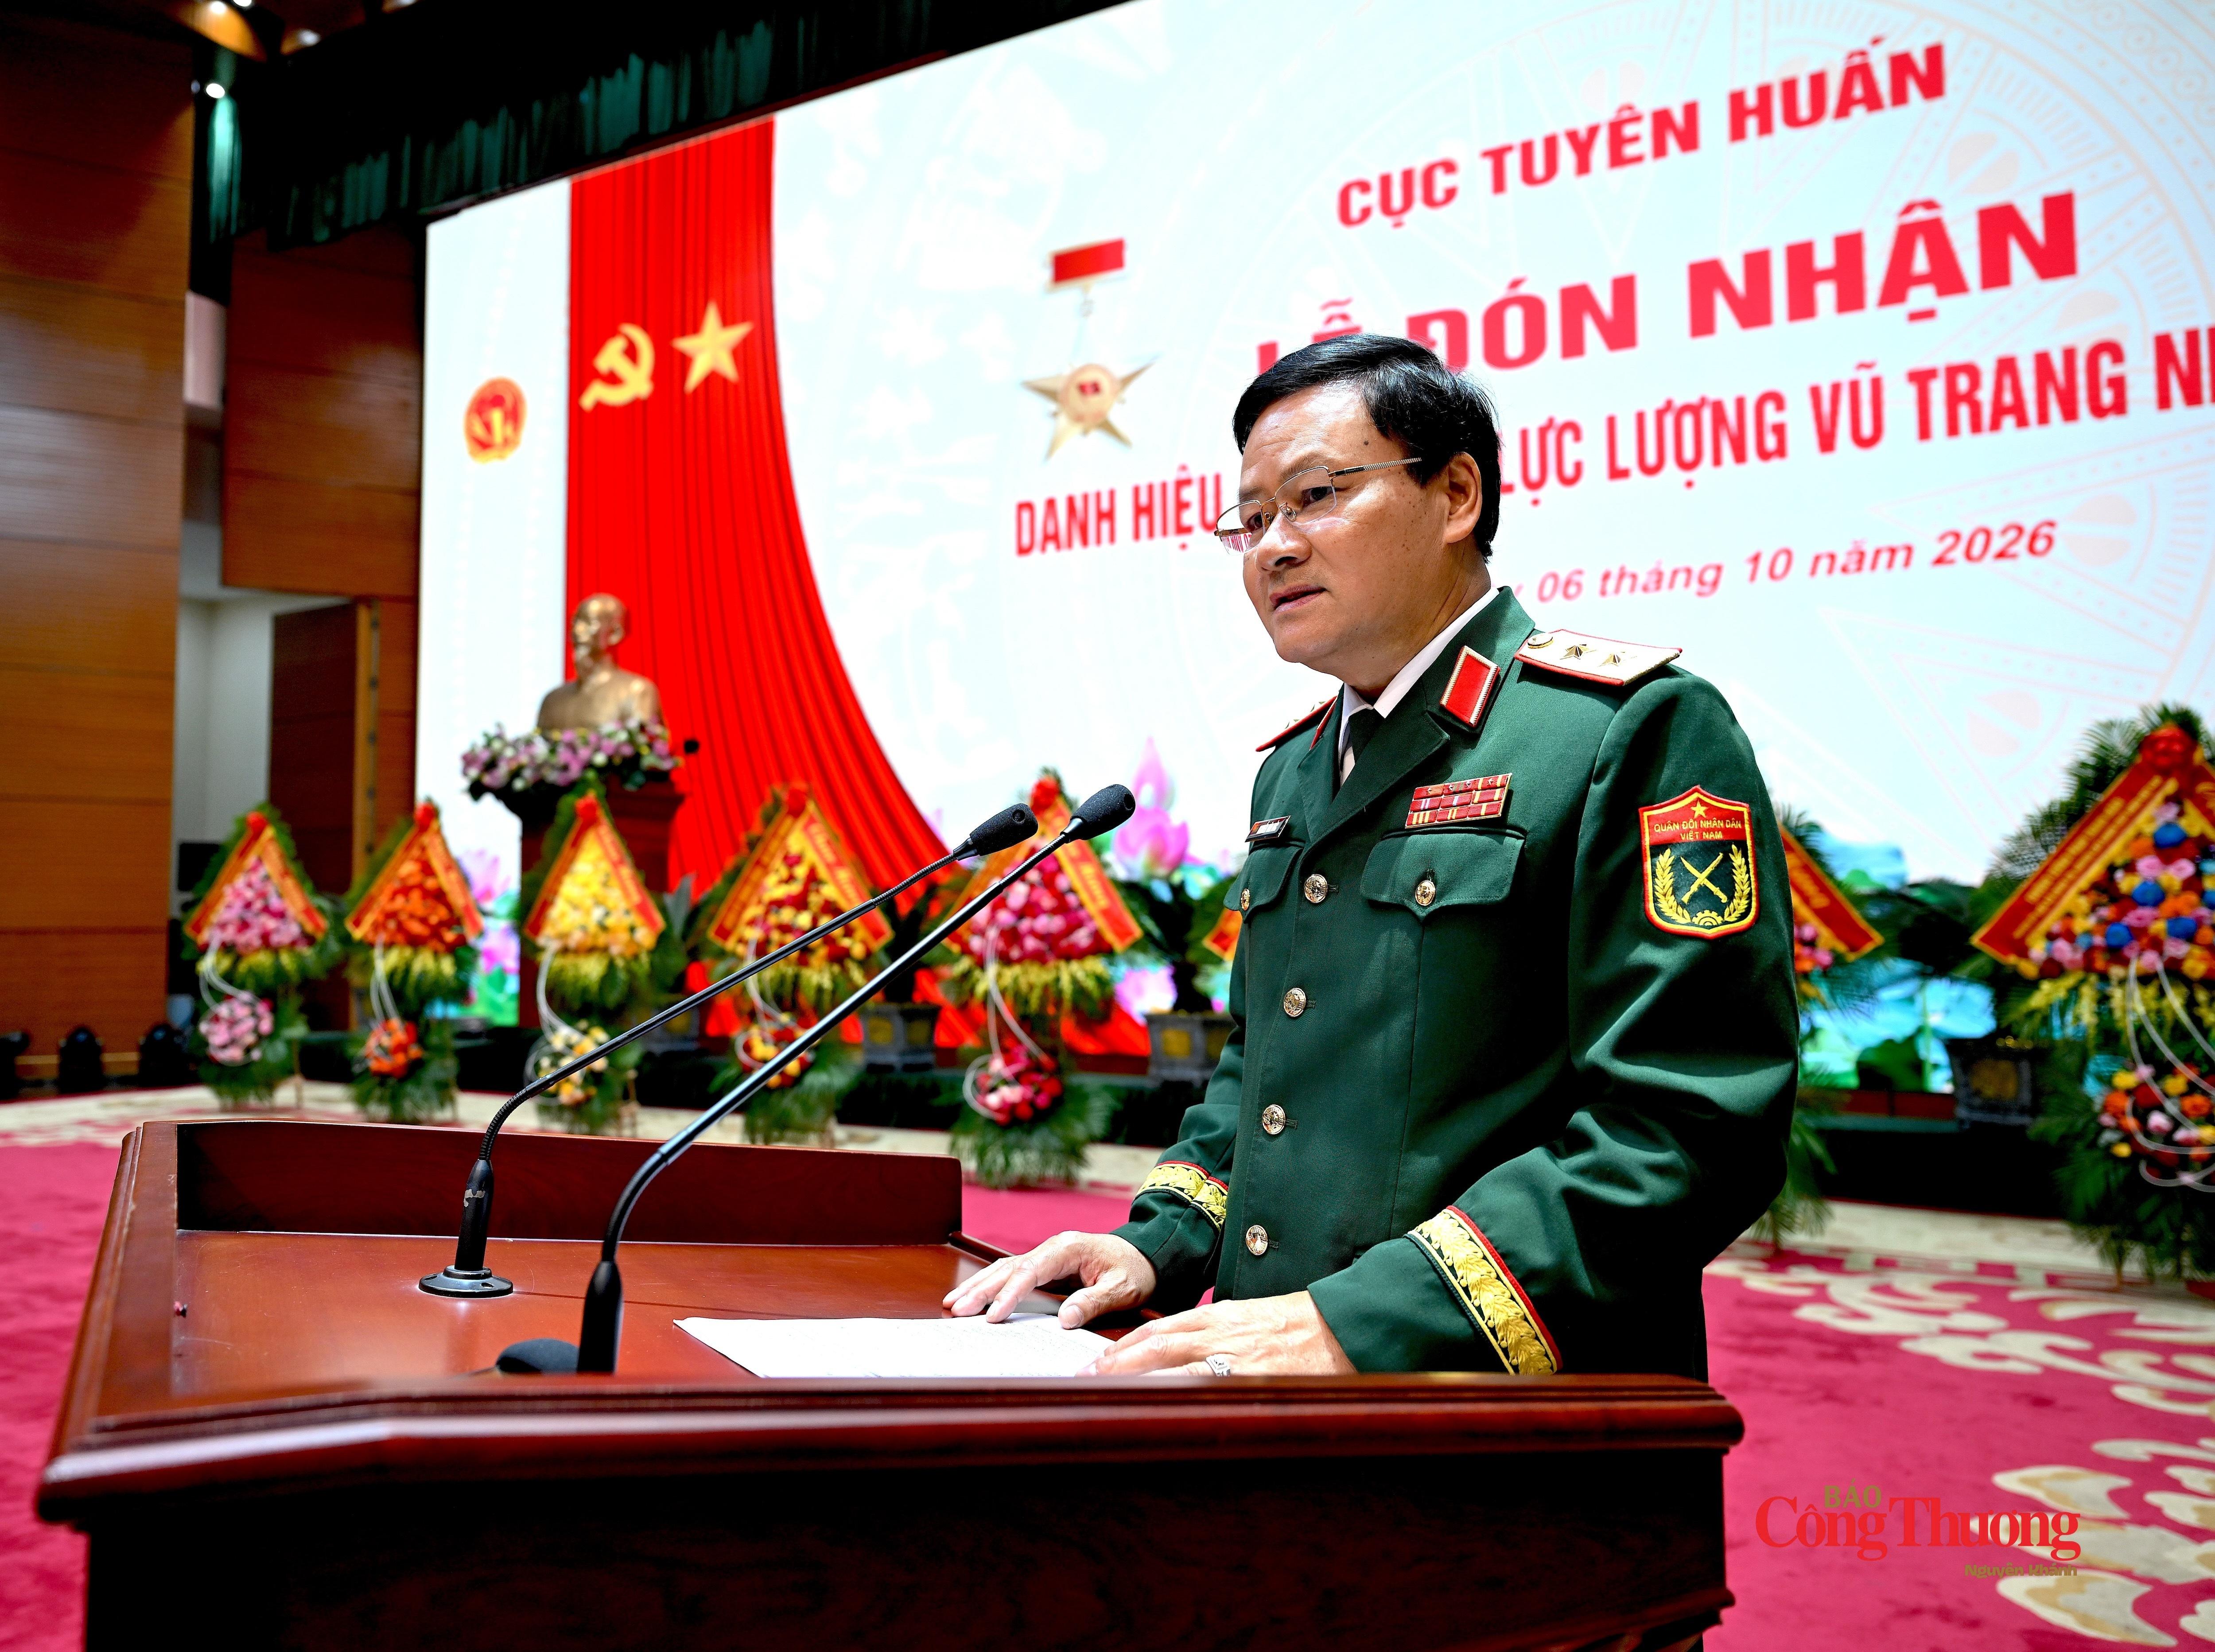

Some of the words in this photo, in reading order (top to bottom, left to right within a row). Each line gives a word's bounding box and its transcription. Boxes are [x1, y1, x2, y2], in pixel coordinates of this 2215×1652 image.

[1337, 159, 1458, 228] CỤC
[1480, 101, 1700, 195] TUYÊN
[1728, 36, 1947, 143] HUẤN
[1687, 190, 2078, 339] NHẬN
[1606, 390, 1788, 489] LƯỢNG
[1808, 361, 1885, 455] VŨ
[1906, 339, 2128, 442] TRANG
[1015, 488, 1116, 557] DANH
[1132, 464, 1222, 550] HIỆU
[1538, 568, 1583, 602] 06
[1599, 559, 1723, 598] tháng
[1745, 547, 1794, 583] 10
[1809, 540, 1914, 578] năm
[1931, 520, 2056, 566] 2026
[1654, 820, 1680, 833] QUÂN
[1682, 819, 1698, 830] ĐỘI
[1700, 818, 1724, 828] NHÂN
[1725, 818, 1741, 828] DÂN
[1680, 831, 1699, 840] VIỆT
